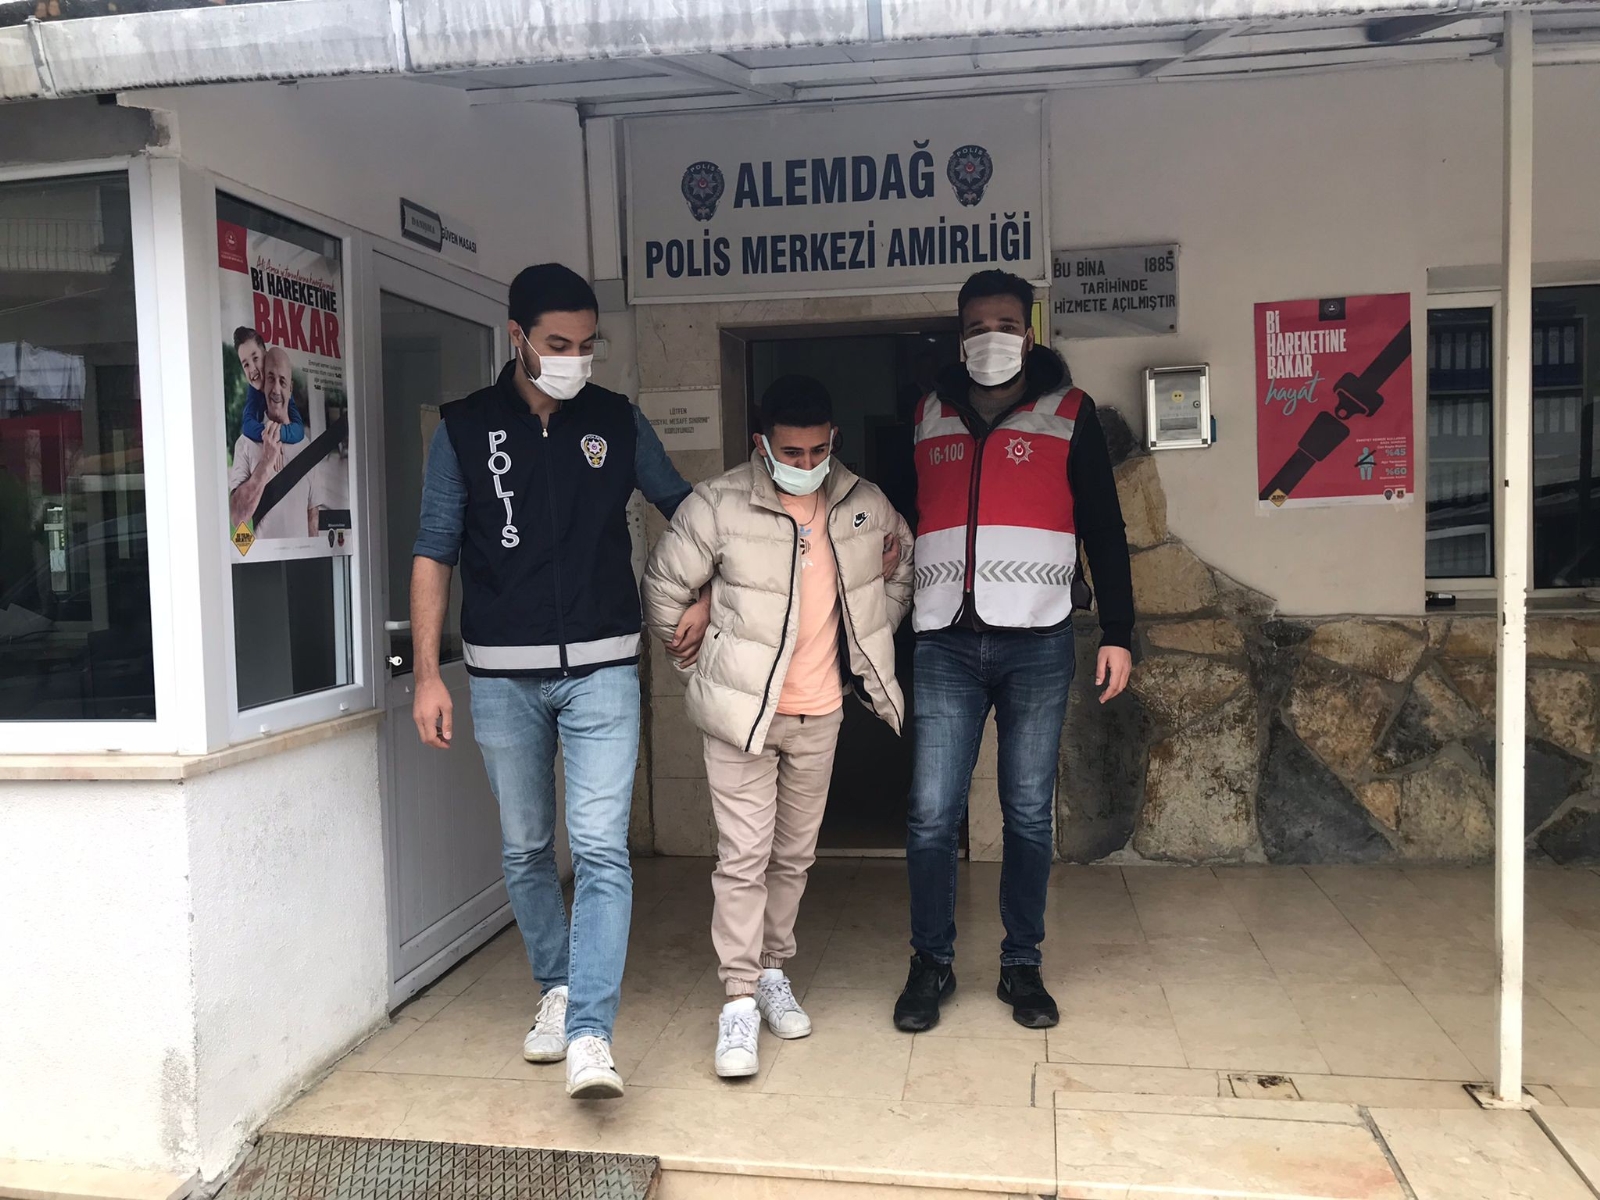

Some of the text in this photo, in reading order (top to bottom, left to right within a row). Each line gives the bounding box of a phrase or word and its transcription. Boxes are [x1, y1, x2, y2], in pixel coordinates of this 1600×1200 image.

[956, 147, 984, 157] POLİS
[733, 139, 935, 208] ALEMDAĞ
[459, 235, 477, 254] MASASI
[645, 211, 1032, 278] POLİS MERKEZİ AMİRLİĞİ
[1053, 256, 1174, 278] BU BİNA 1885
[267, 270, 338, 313] HAREKETİNE
[1080, 277, 1148, 295] TARİHİNDE
[1054, 294, 1176, 314] HİZMETE AÇILMIŞTIR
[252, 291, 342, 359] BAKAR
[1266, 328, 1347, 357] HAREKETİNE
[1267, 354, 1313, 379] BAKAR
[1264, 370, 1326, 416] hayat
[928, 442, 965, 466] 16-100
[1385, 448, 1406, 457] %45
[1385, 467, 1407, 475] %60
